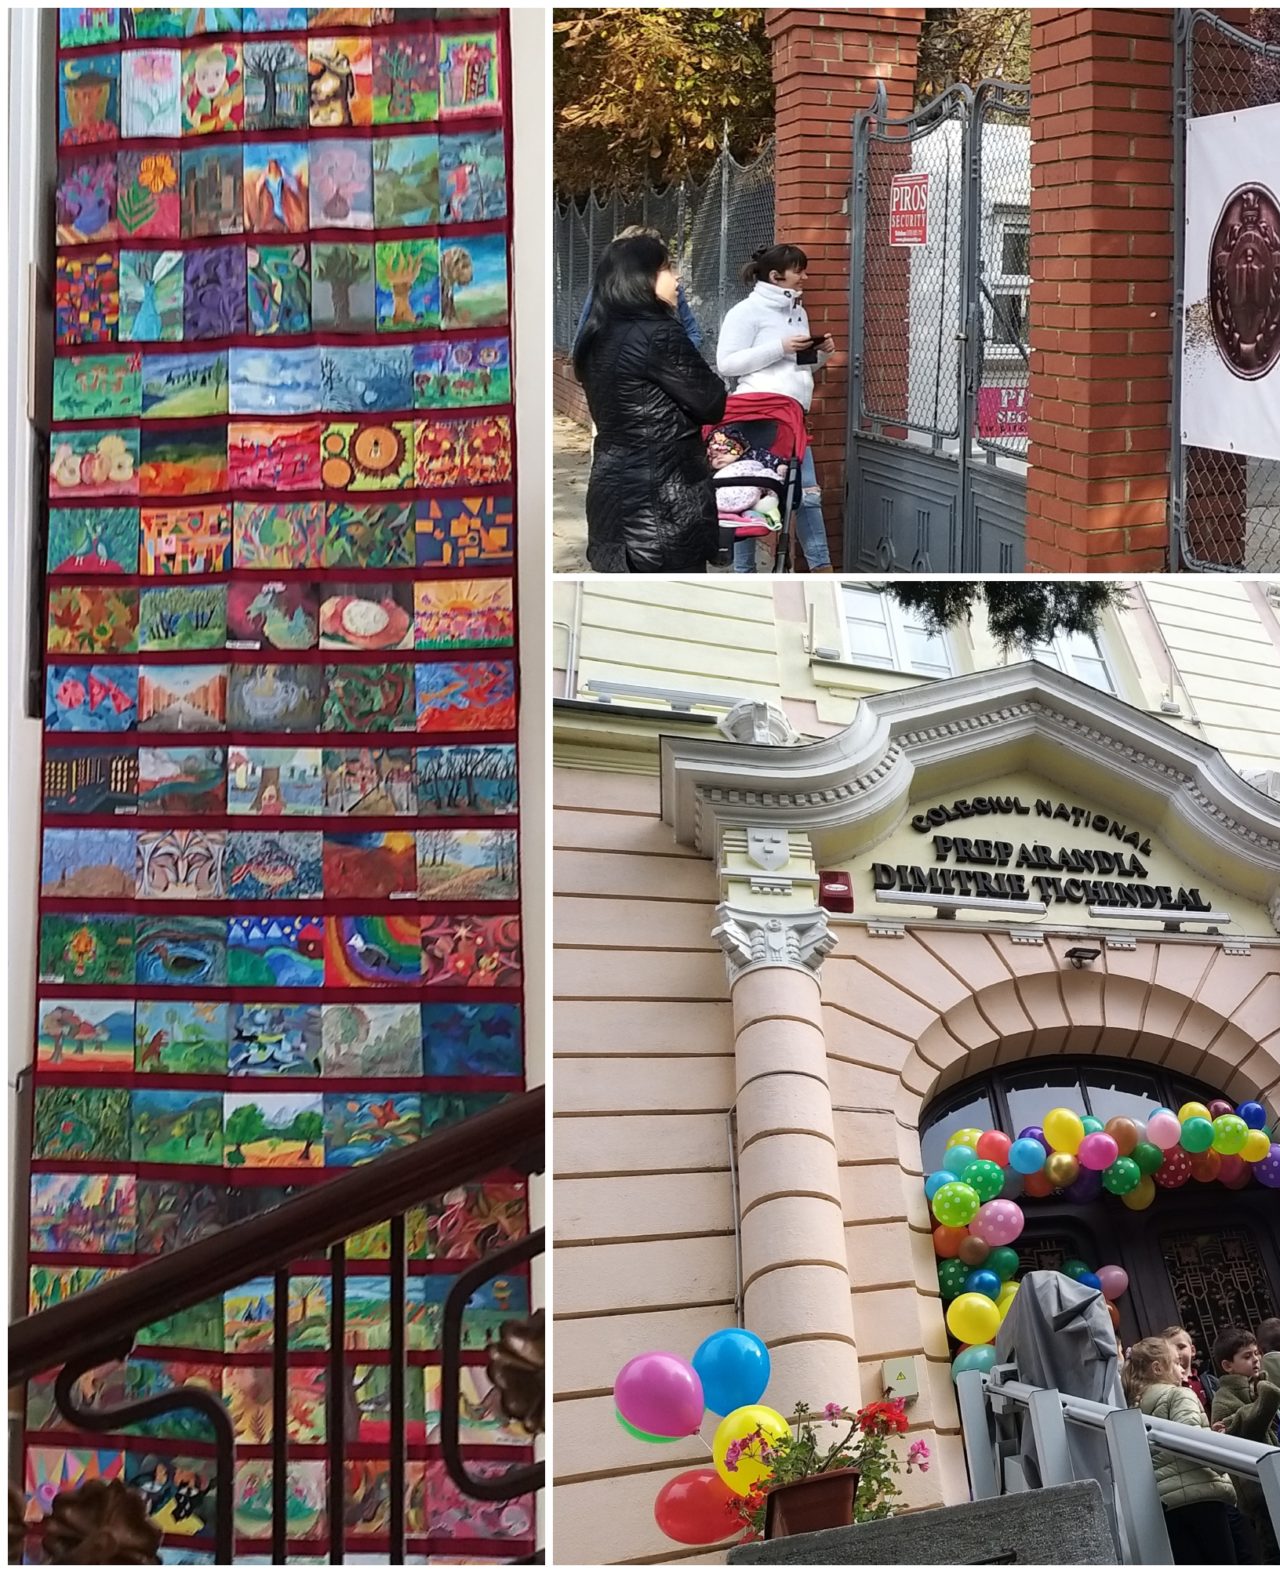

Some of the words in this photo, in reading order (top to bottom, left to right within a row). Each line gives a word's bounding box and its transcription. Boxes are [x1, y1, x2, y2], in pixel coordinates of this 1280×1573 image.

[892, 184, 927, 212] PIROS
[891, 213, 926, 228] SECURITY
[911, 796, 1030, 833] COLEGIUL
[933, 835, 1148, 878] PREPARANDIA
[872, 863, 1029, 900] DIMITRIE
